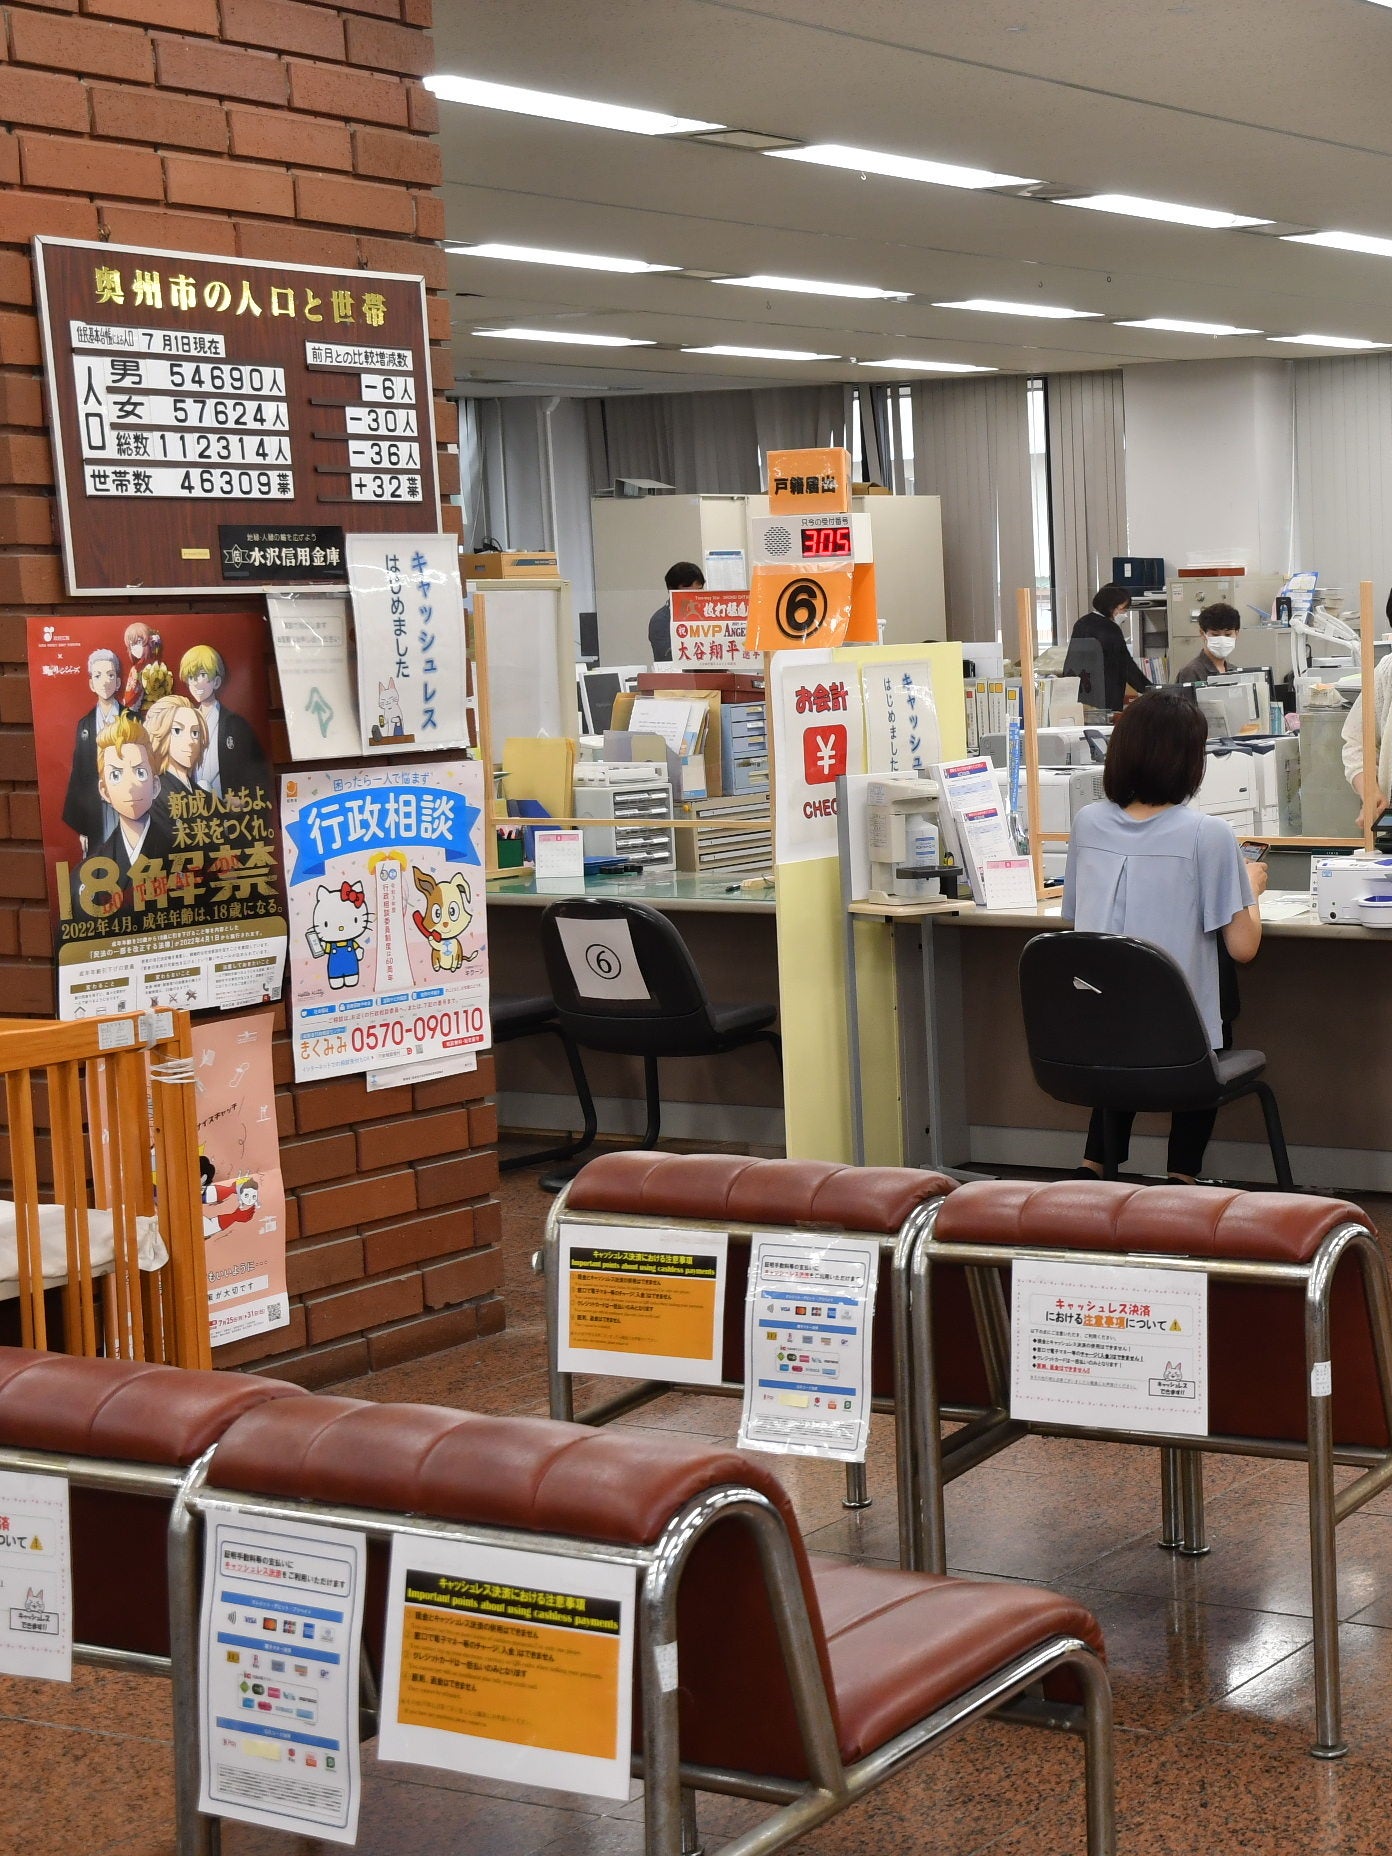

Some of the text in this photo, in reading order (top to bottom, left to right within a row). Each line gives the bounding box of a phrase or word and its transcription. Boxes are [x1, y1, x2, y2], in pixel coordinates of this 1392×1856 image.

[94, 265, 388, 327] 奥州市の人口と世帯
[311, 346, 408, 368] 前月との比較増減数
[110, 359, 282, 393] 男 54690人
[84, 365, 107, 451] 人口
[113, 395, 286, 428] 女 57624人
[116, 433, 289, 462] 総数 112314人
[90, 469, 291, 495] 世帯数 46309世帯
[354, 476, 419, 499] +32世帯
[801, 517, 848, 526] 只今の受付番号
[250, 546, 340, 567] 水沢信用金庫
[804, 529, 850, 556] 305
[386, 553, 410, 678] はじめました
[689, 625, 722, 638] MVP
[724, 623, 746, 637] ANGE
[411, 551, 438, 730] キャッシュレス
[679, 640, 739, 661] 大谷翔平
[795, 682, 848, 715] お会計
[883, 677, 899, 771] はじめました
[902, 673, 923, 768] キャッシュ
[168, 786, 273, 819] 新成人たちよ、
[803, 800, 838, 819] CHEC
[172, 815, 274, 848] 未来をつくれ。
[308, 793, 455, 855] 行政相談
[56, 842, 280, 921] 18解禁
[351, 1007, 484, 1053] 0570-090110
[301, 1035, 347, 1060] きくみみ
[1046, 1311, 1167, 1331] における注意事項について
[1055, 1298, 1151, 1316] キャッシュレス決済
[407, 1588, 619, 1630] Important points about using cashless payments
[438, 1577, 586, 1611] キャッシュレス決済における注意事項
